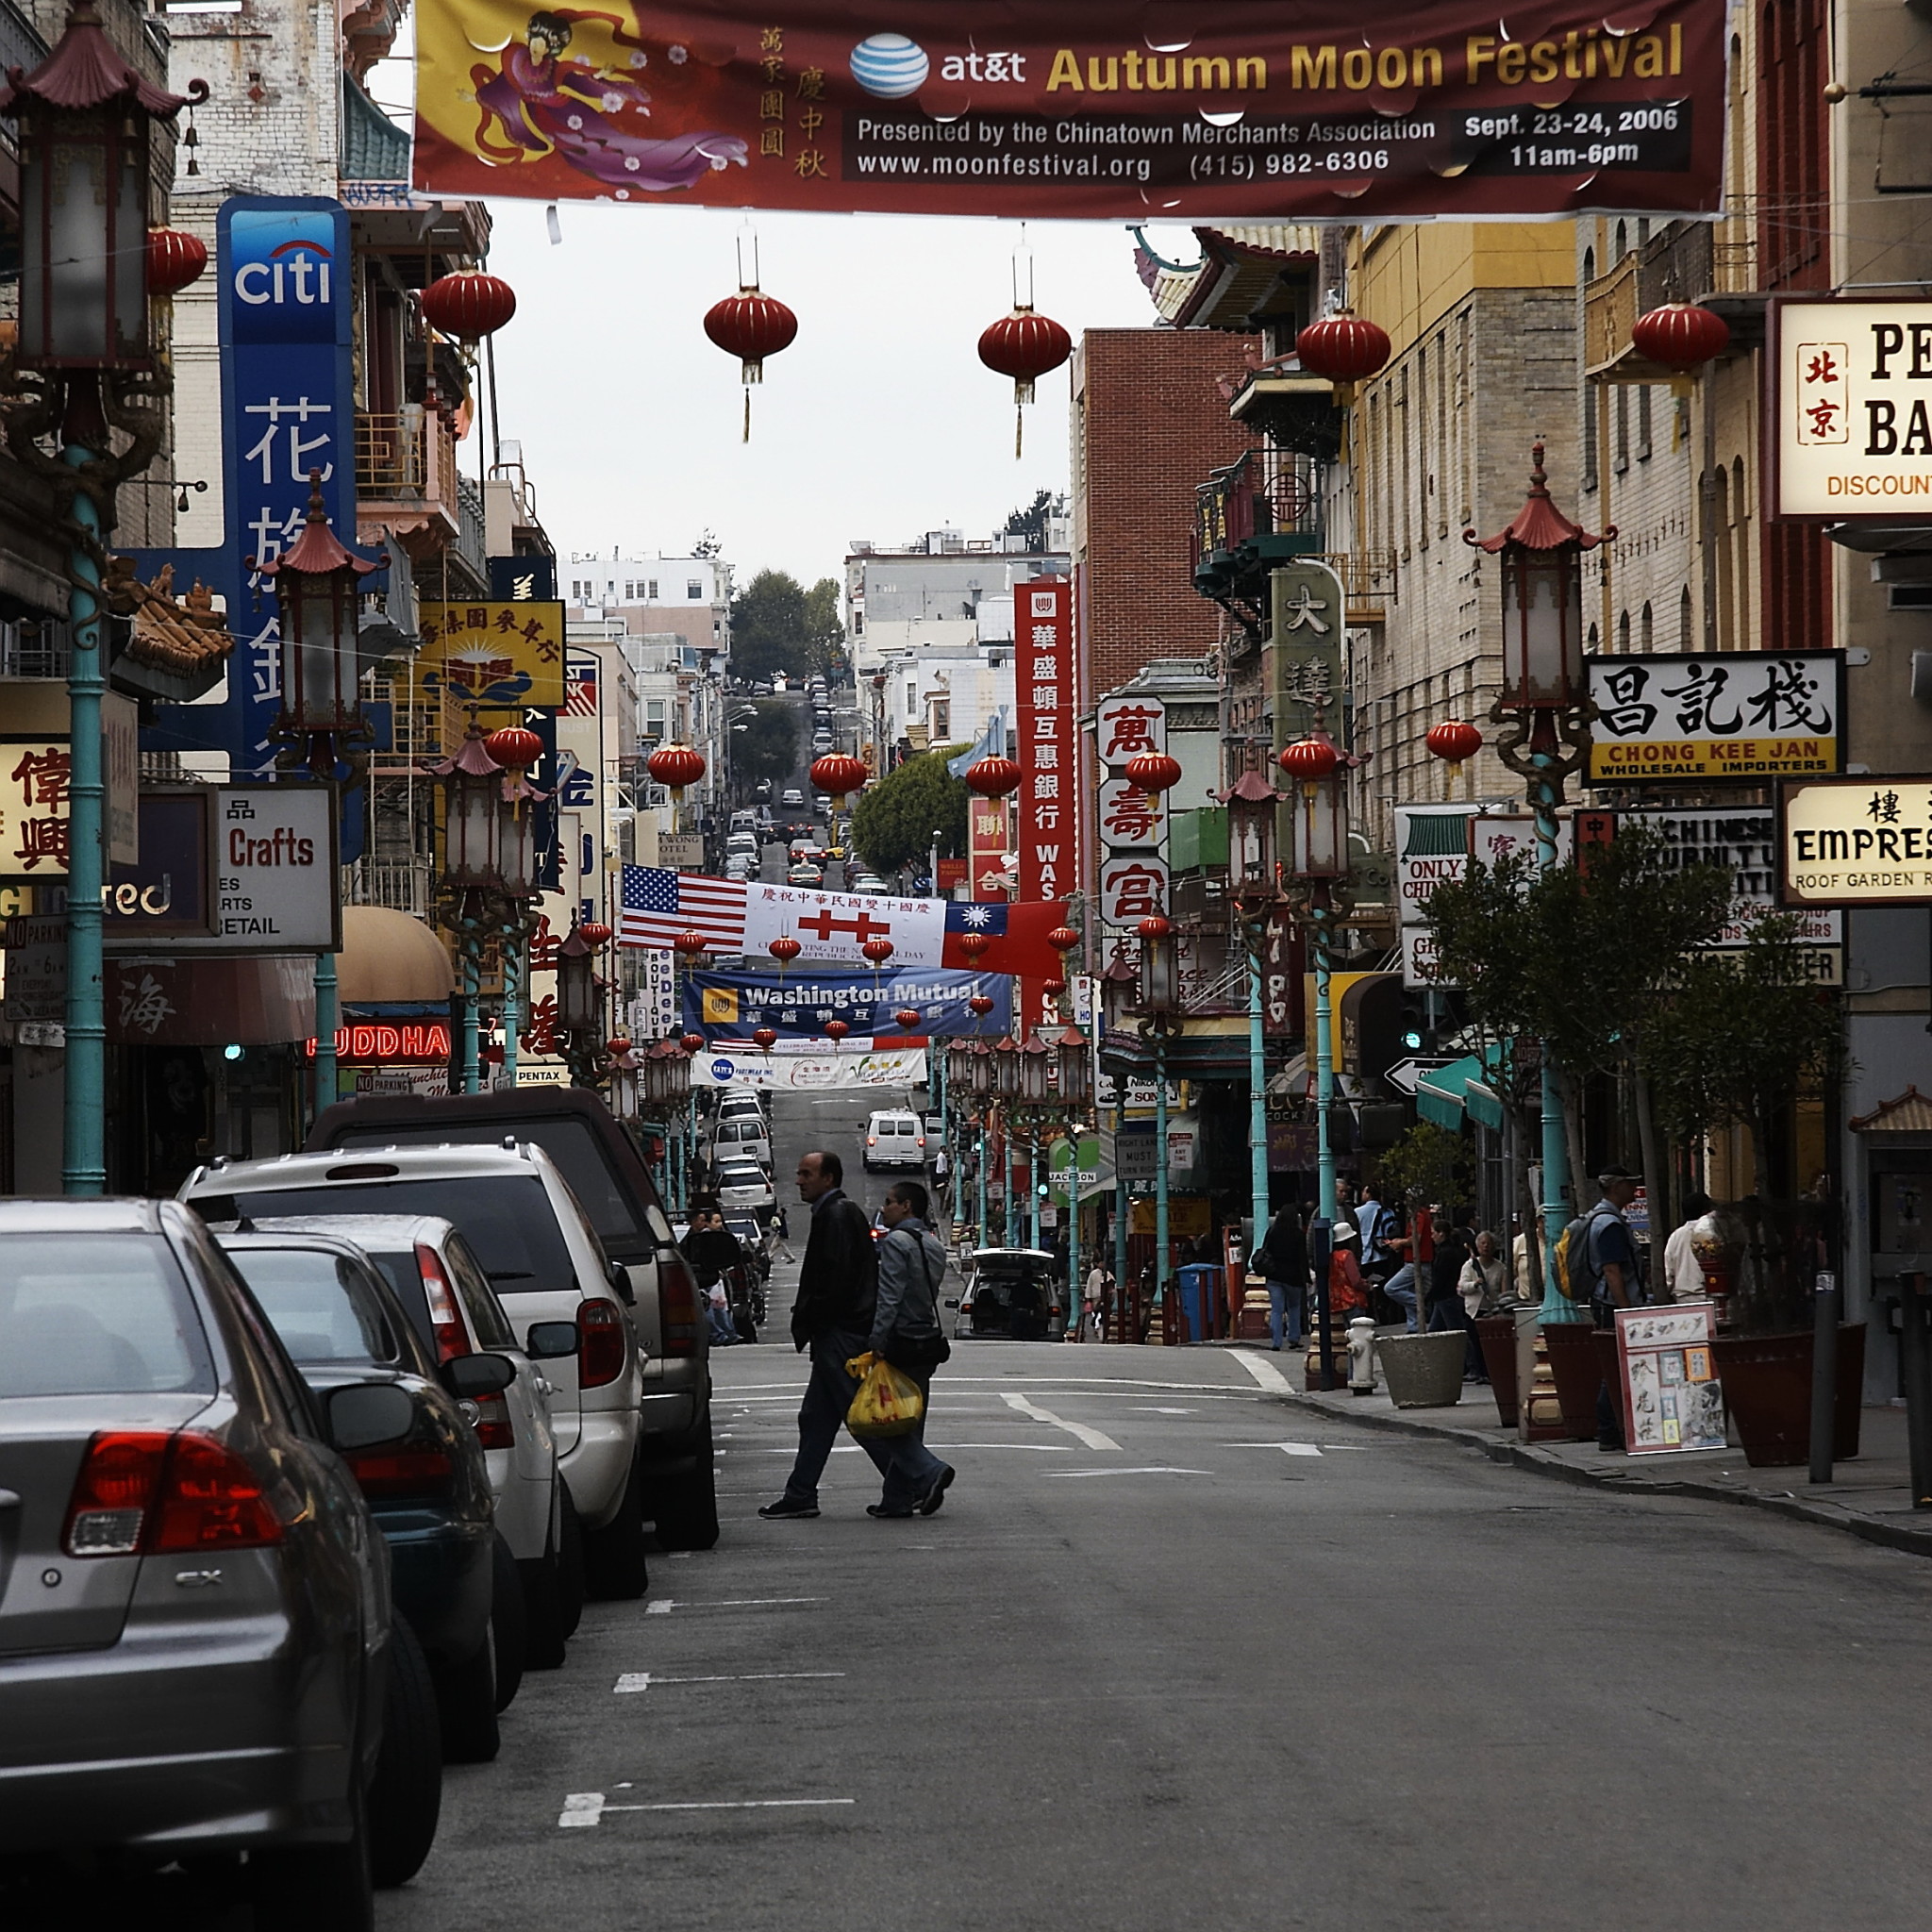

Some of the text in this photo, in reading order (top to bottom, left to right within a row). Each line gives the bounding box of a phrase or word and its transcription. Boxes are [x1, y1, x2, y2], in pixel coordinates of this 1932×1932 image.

[941, 51, 1026, 82] at&t
[1046, 23, 1683, 92] Autumn Moon Festival
[858, 120, 1436, 147] Presented by the Chinatown Merchants Association
[1465, 109, 1678, 139] Sept. 23-24, 2006
[858, 150, 1390, 181] www.moonfestival.org (415) 982-6306
[1510, 143, 1639, 168] 11am-6pm
[235, 251, 331, 305] citi
[1806, 351, 1840, 438] 北京
[1031, 624, 1059, 829] 華盛頓互惠銀行
[1608, 741, 1818, 762] CHONG KEE JAN
[1601, 760, 1827, 775] WHOLESALE IMPORTERS
[1662, 817, 1774, 842] CHINESE
[229, 827, 314, 866] Crafts
[1410, 859, 1462, 878] ONLY
[1796, 875, 1839, 889] ROOF
[1847, 874, 1914, 887] GARDEN
[219, 898, 253, 910] RTS
[650, 953, 659, 1037] BOUTIQUE
[745, 980, 980, 1008] Washington Mutual
[745, 1005, 977, 1024] 華盛頓互銀行
[358, 1074, 408, 1091] NO PARKING
[519, 1071, 560, 1081] PENTAX
[1126, 1152, 1151, 1161] MUST
